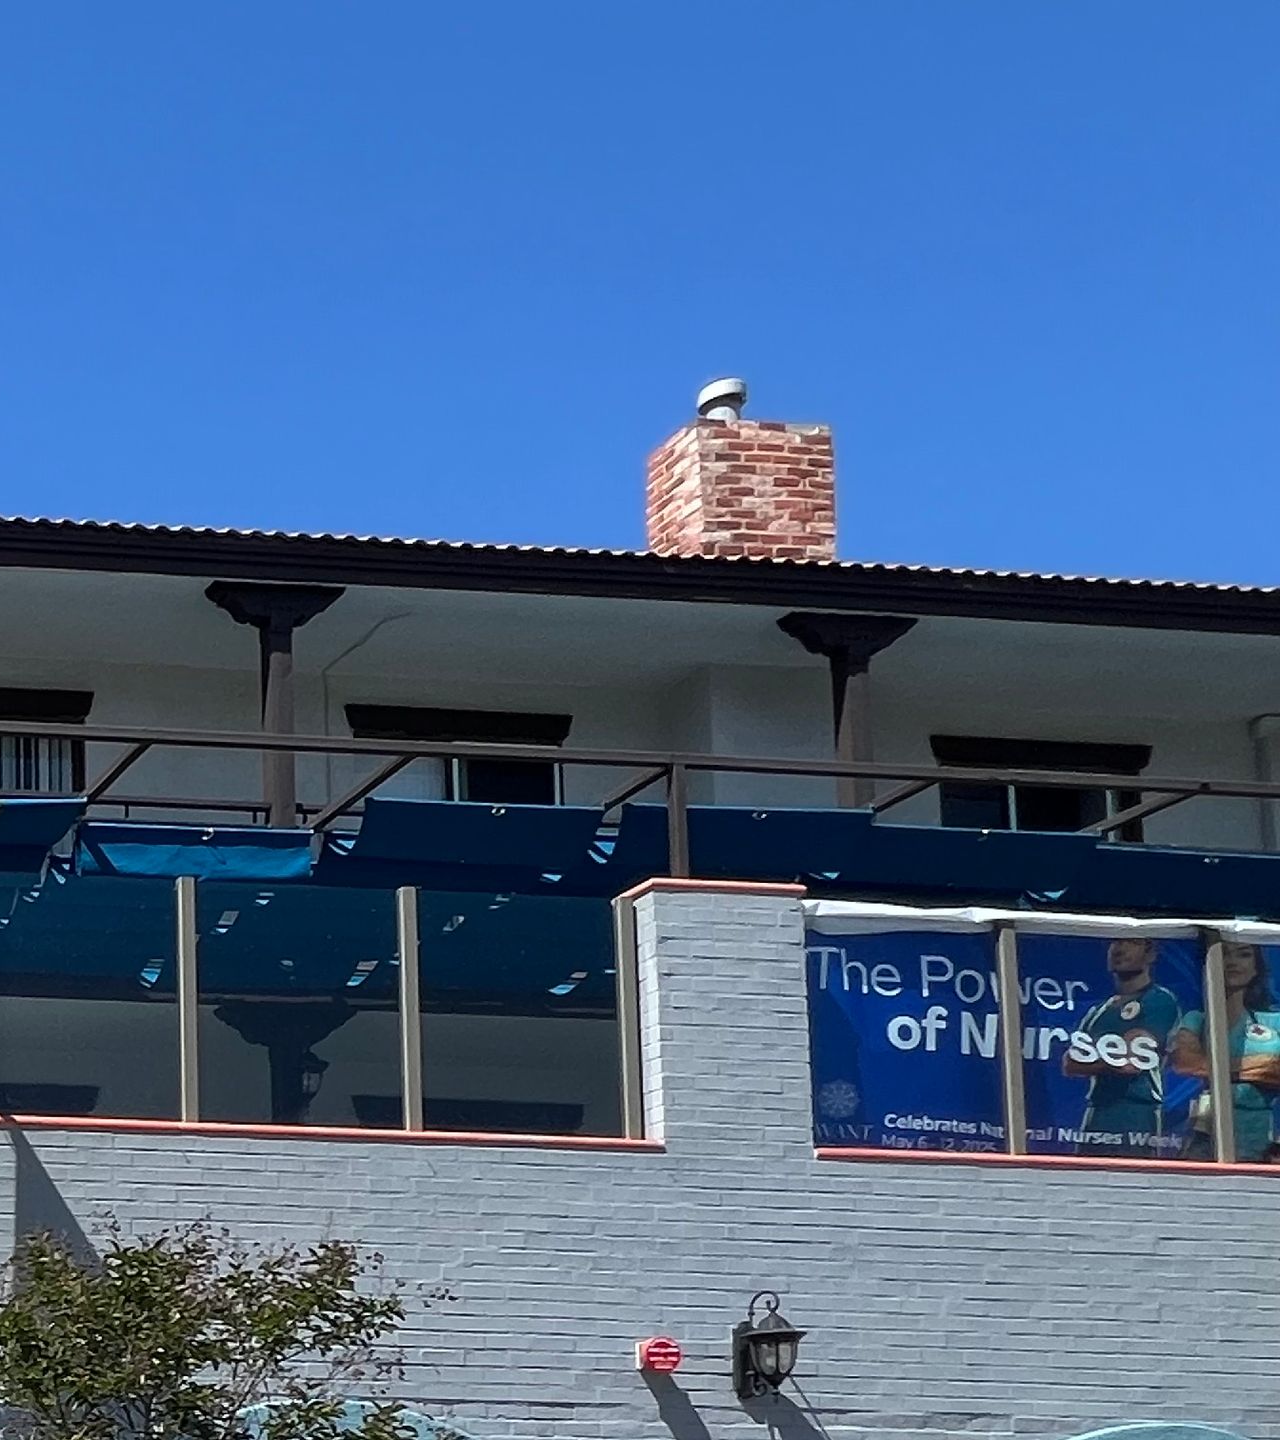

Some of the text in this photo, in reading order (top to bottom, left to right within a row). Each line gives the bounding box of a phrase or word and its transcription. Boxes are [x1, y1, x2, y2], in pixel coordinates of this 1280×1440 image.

[806, 945, 901, 997] The
[887, 1006, 948, 1052] of
[884, 1113, 977, 1135] Celebrates
[1058, 1128, 1123, 1145] Nurses
[1128, 1131, 1182, 1150] Week
